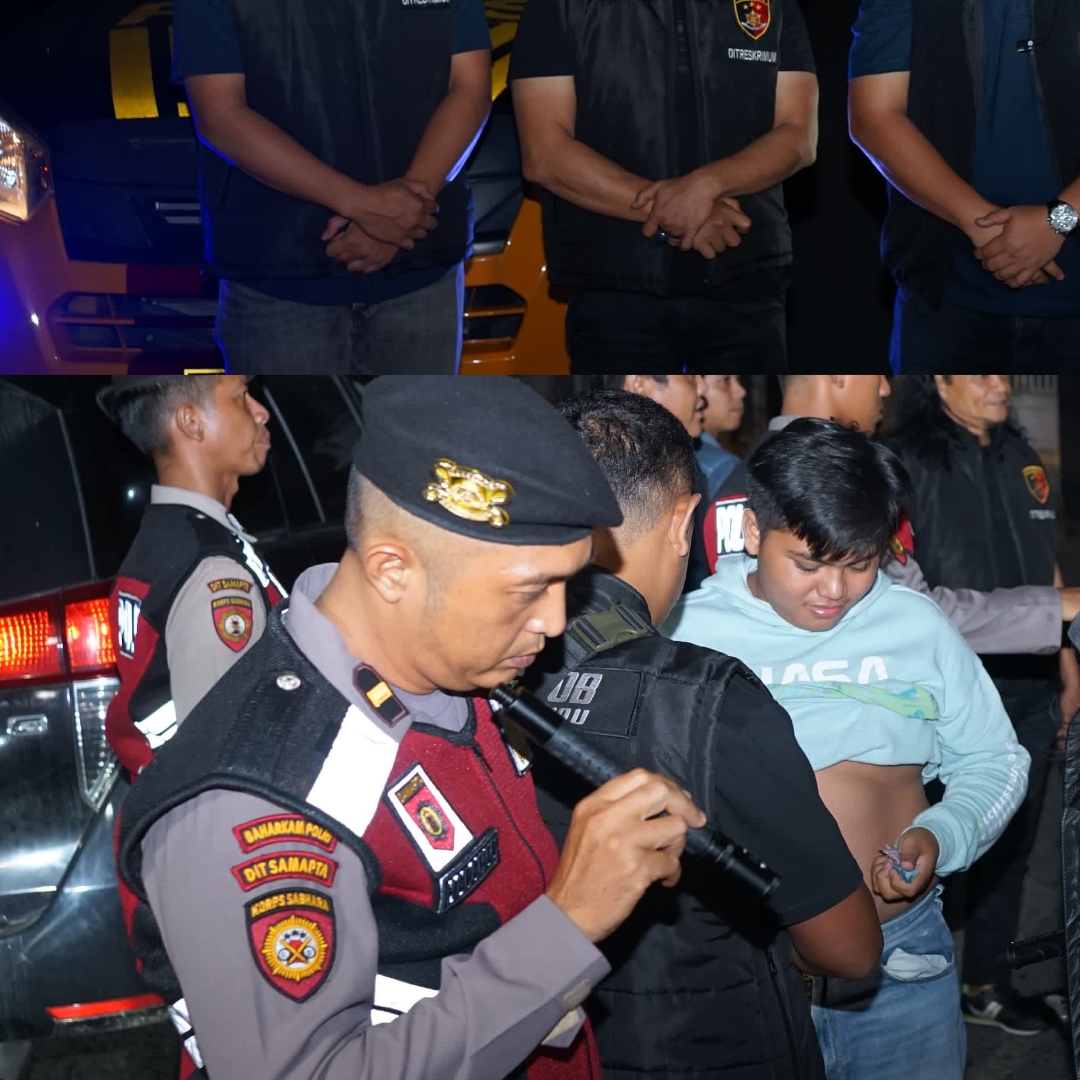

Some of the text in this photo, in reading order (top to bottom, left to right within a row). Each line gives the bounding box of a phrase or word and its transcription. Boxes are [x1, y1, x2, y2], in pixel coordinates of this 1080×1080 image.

[243, 819, 333, 844] BAHARKAM POLRI
[243, 856, 329, 883] DIT SAMAPTA
[250, 892, 330, 918] KORPS SABHARA
